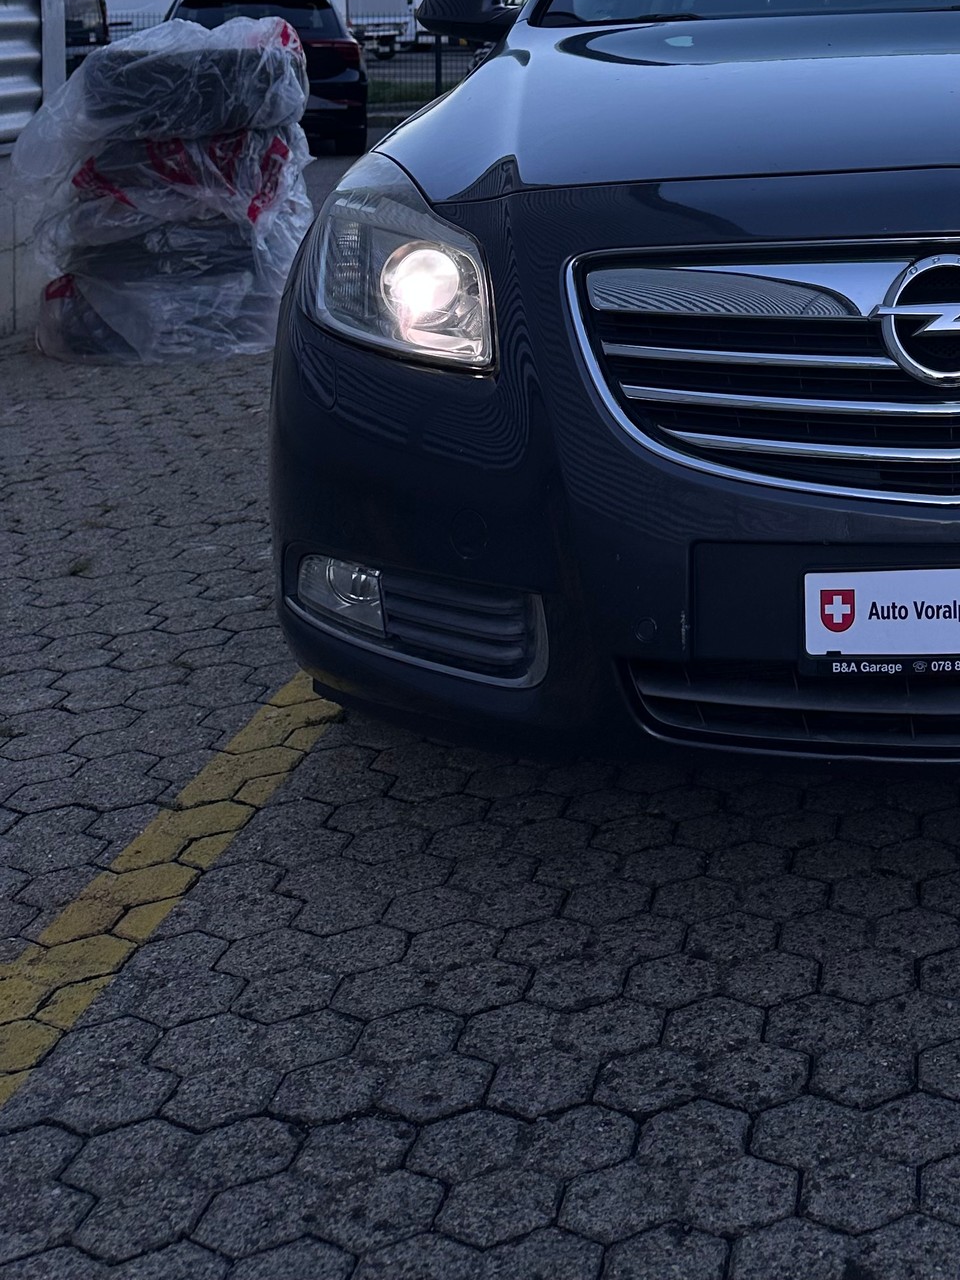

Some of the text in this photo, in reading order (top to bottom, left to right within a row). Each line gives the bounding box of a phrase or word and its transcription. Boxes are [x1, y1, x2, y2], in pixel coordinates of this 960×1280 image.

[868, 601, 908, 620] Auto
[832, 662, 858, 673] B&A
[860, 661, 903, 674] Garage
[931, 661, 952, 671] 078
